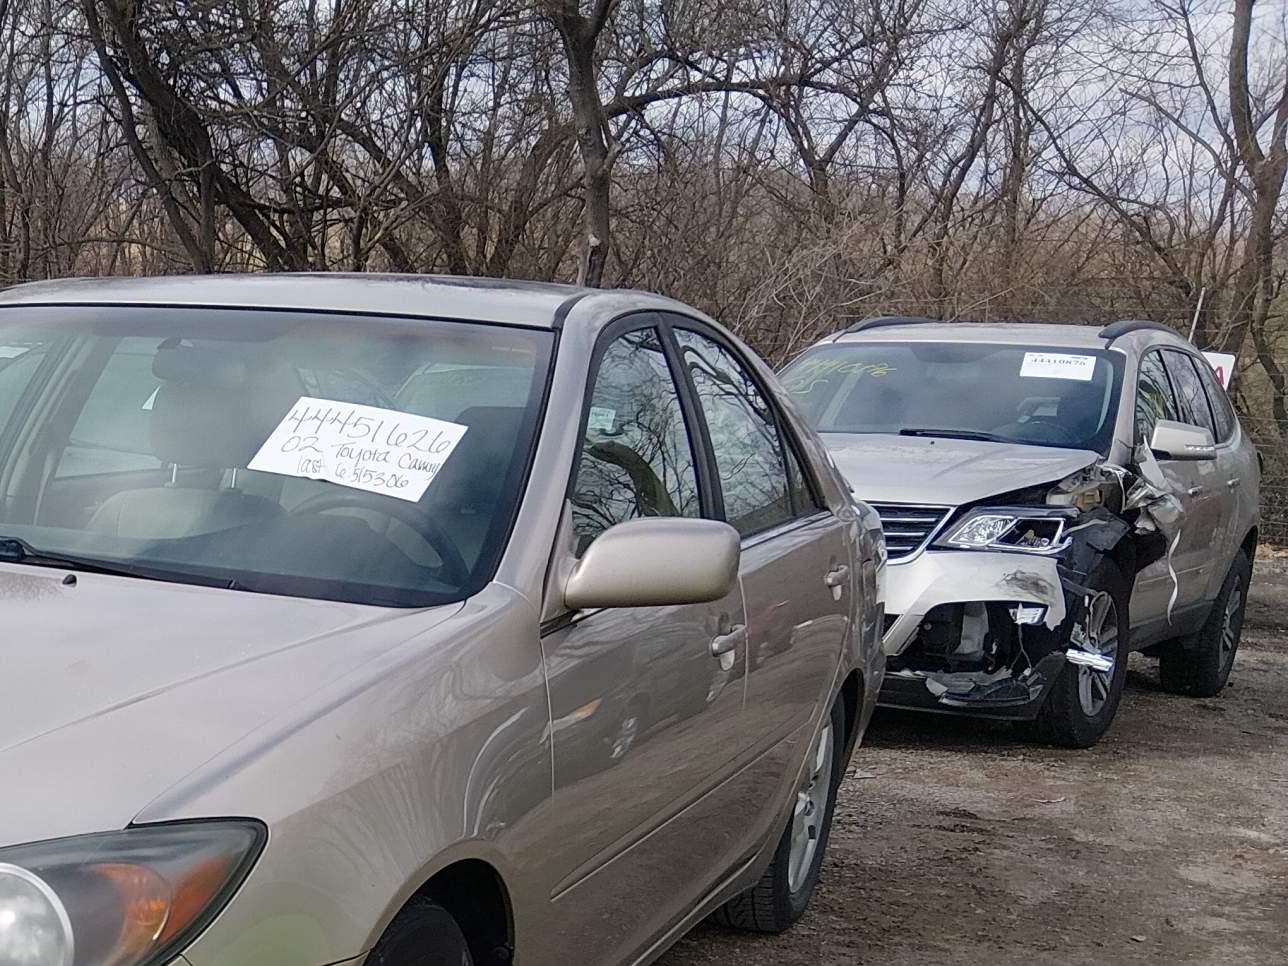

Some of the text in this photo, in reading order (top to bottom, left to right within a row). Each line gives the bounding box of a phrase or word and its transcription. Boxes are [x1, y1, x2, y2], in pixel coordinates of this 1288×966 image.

[288, 407, 451, 454] 44451626
[281, 436, 324, 453] 02
[331, 442, 390, 468] Toyota
